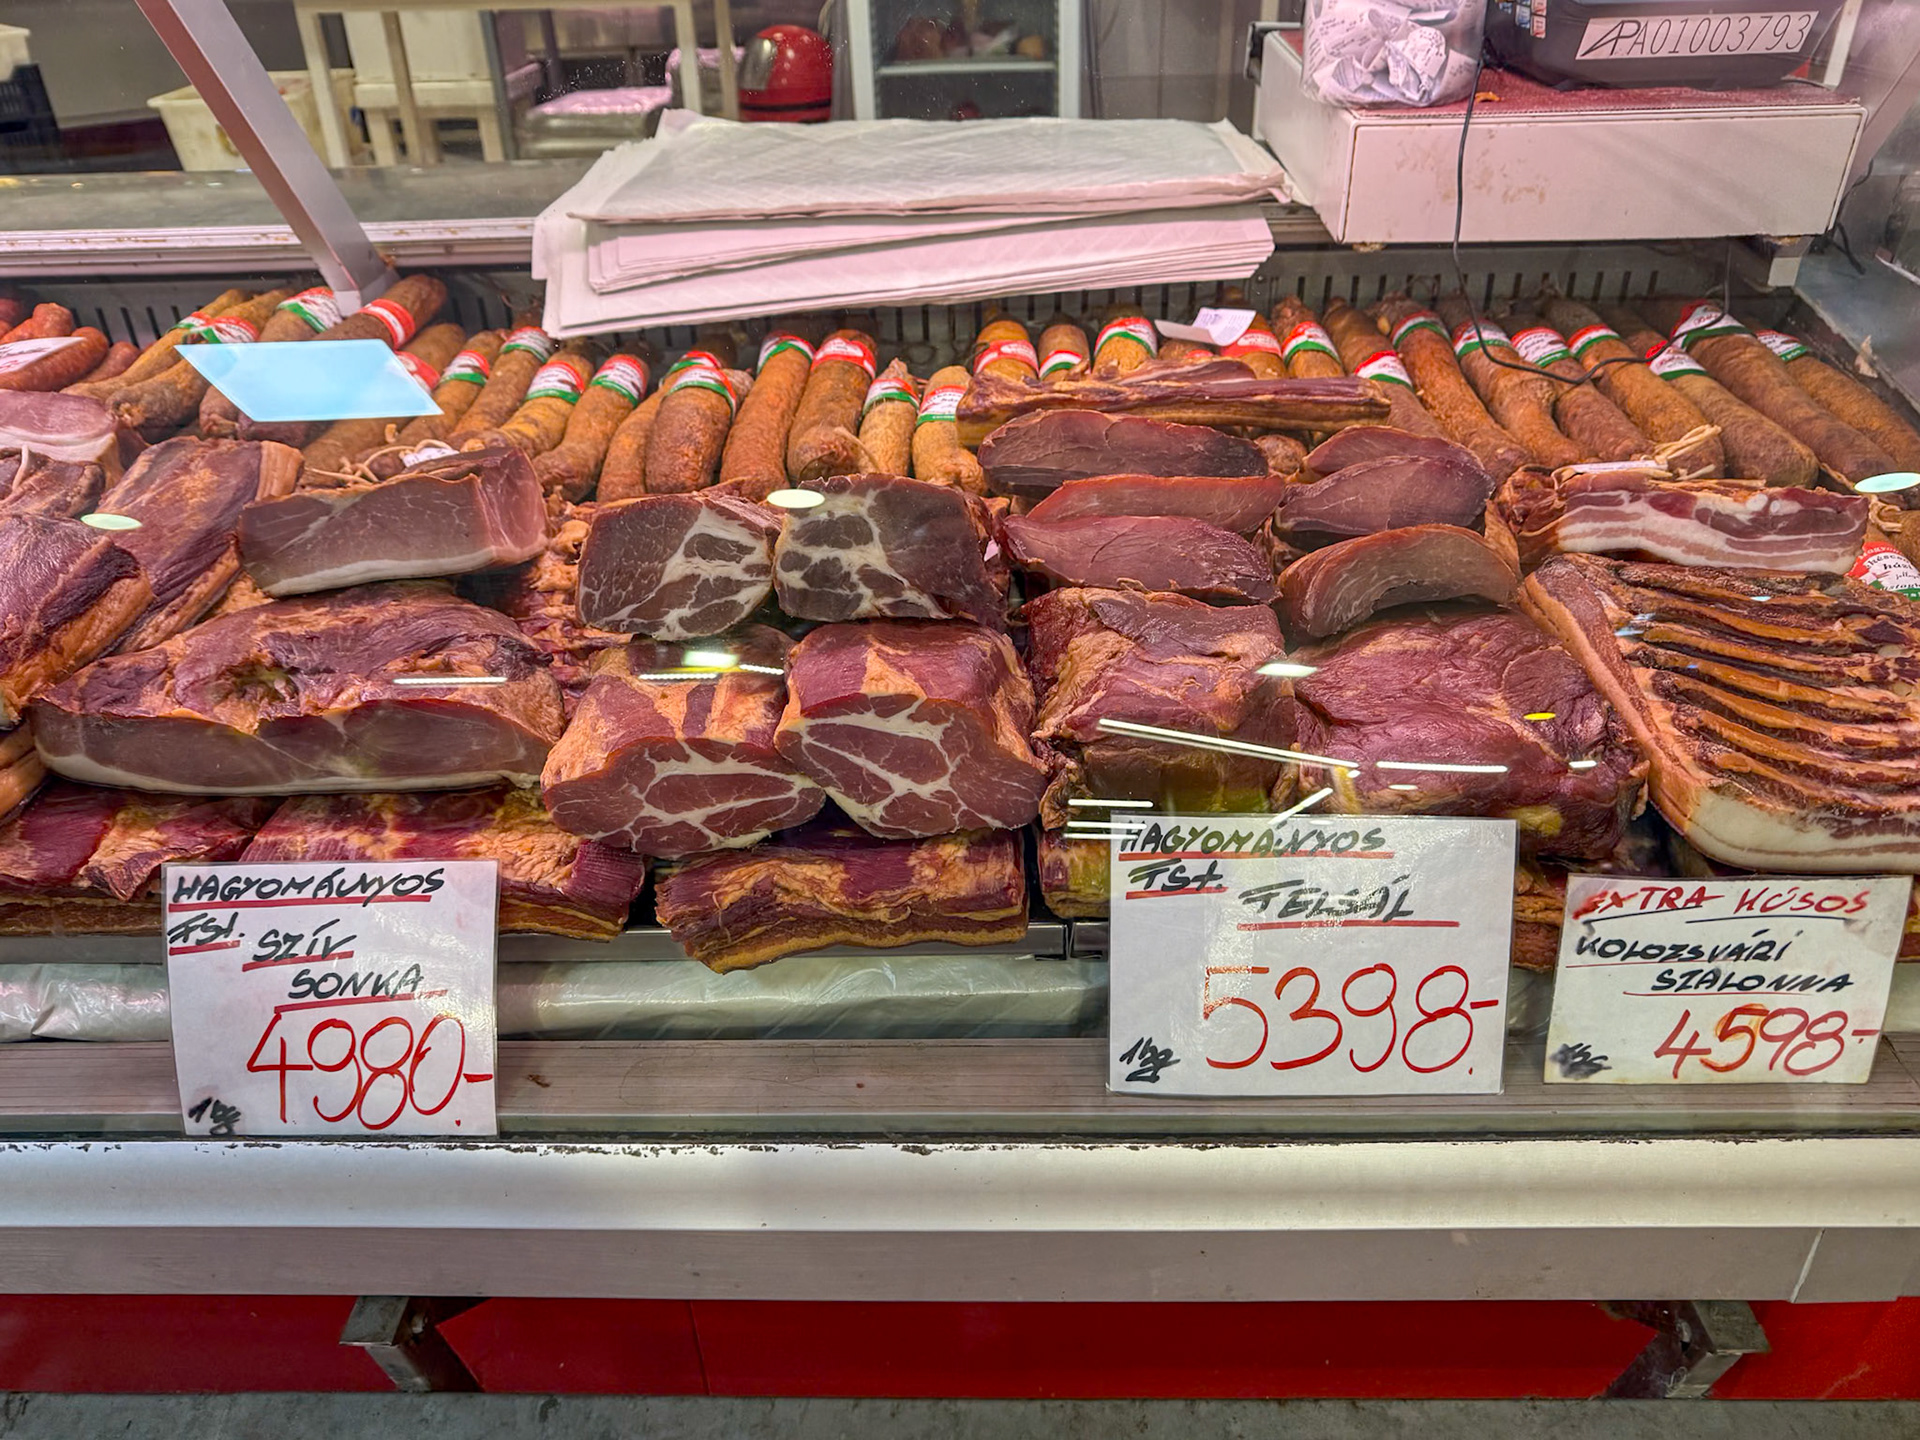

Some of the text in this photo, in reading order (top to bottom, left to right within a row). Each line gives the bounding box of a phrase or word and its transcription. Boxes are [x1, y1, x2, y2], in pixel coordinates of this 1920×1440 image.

[172, 867, 445, 907] HAGYOMÁNYOS
[1572, 885, 1725, 920] EXTRA
[252, 918, 358, 963] SZÍV
[288, 963, 424, 999] SONKA
[1650, 967, 1854, 993] SZALONNA
